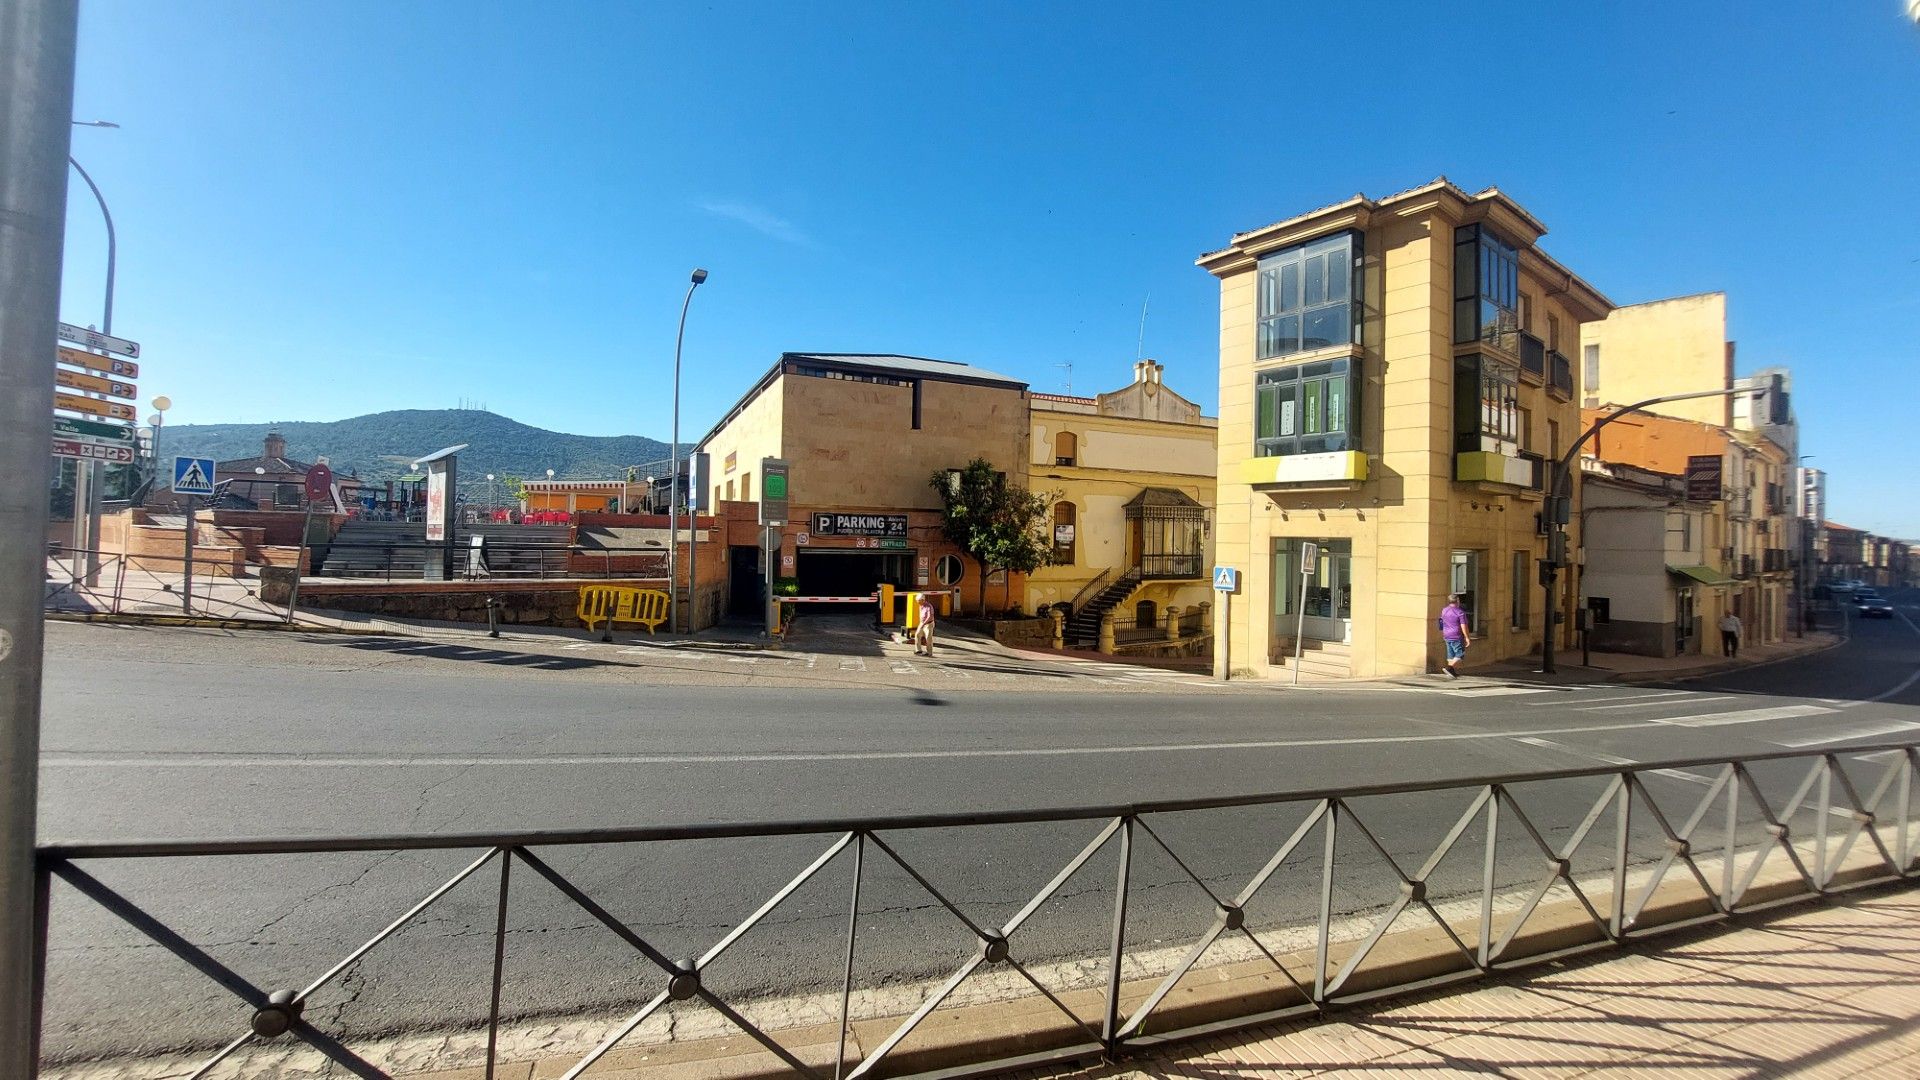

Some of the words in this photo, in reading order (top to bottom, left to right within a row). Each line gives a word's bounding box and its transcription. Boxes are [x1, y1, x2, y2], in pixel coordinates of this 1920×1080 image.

[819, 517, 830, 532] P
[837, 515, 885, 529] PARKING
[891, 522, 903, 531] 24
